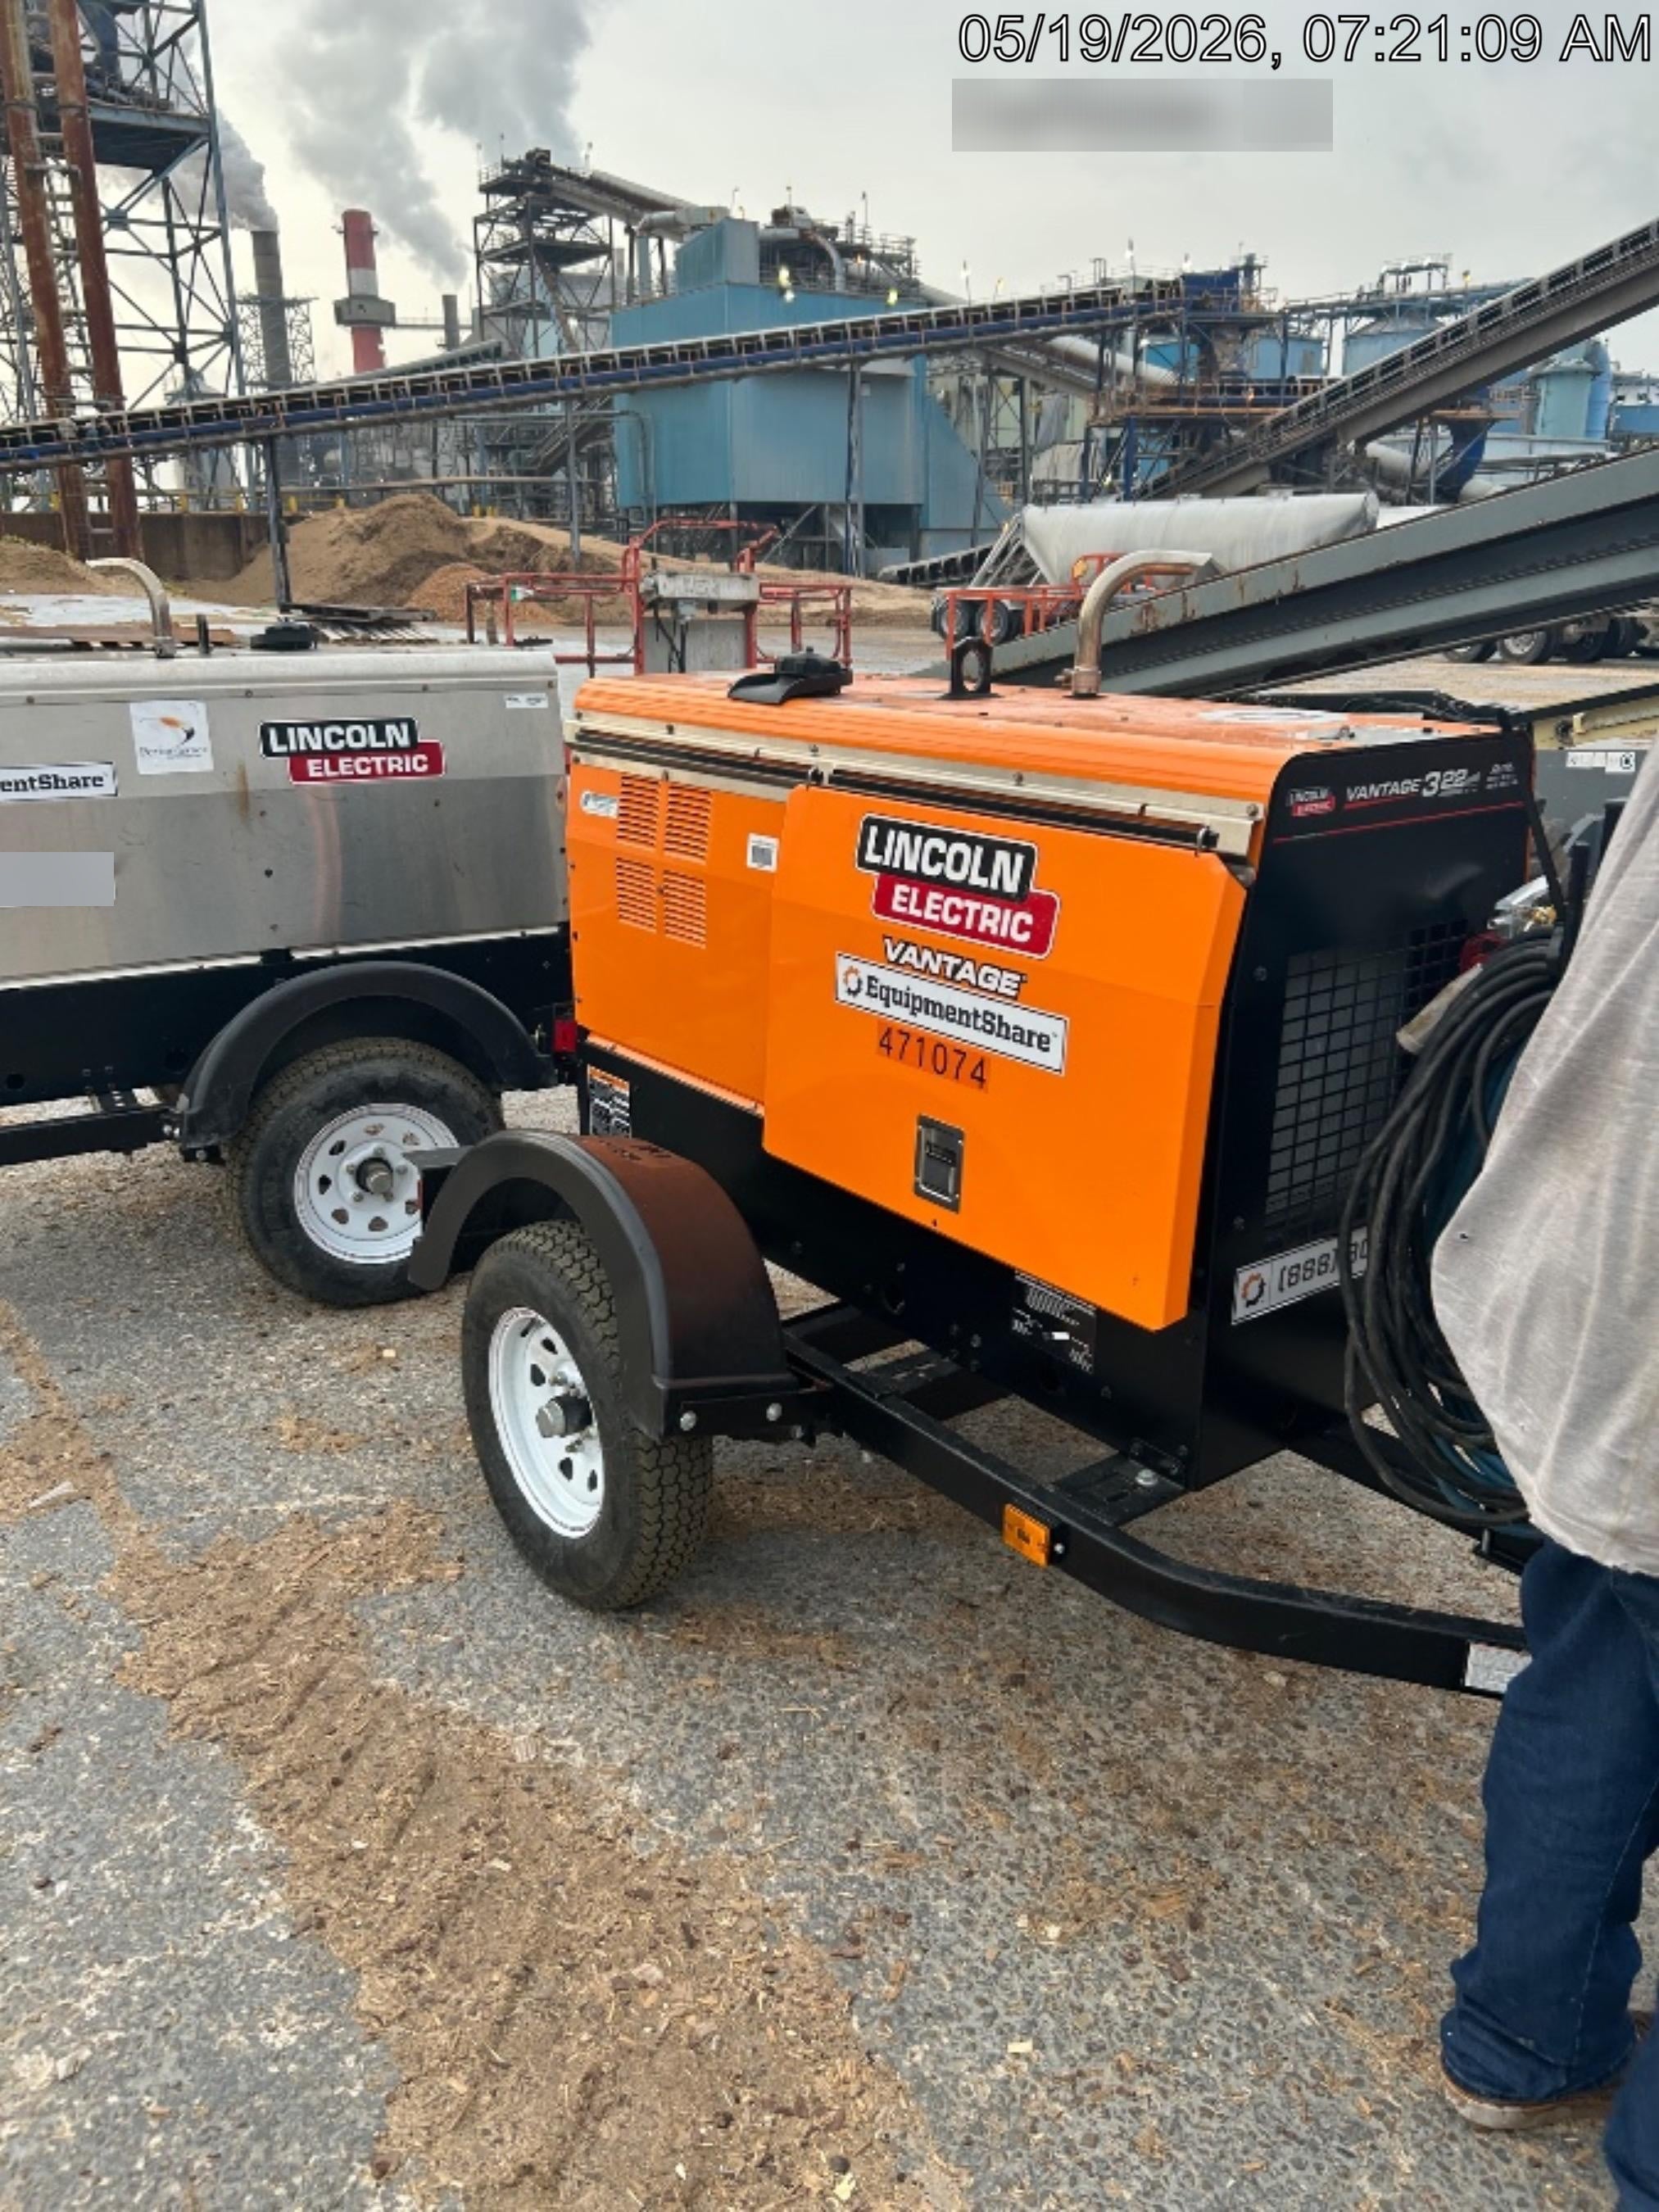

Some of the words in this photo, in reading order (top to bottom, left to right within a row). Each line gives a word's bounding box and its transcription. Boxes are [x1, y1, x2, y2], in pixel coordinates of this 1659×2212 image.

[269, 722, 410, 753] LINCOLN
[306, 753, 428, 778] ELECTRIC
[1346, 778, 1421, 801] VANTAGE
[864, 824, 1025, 894] LINCOLN
[891, 884, 1034, 943] ELECTRIC
[883, 936, 1023, 999] VANTAGE
[865, 975, 1051, 1054] EquipmentShare
[878, 1026, 987, 1090] 471074
